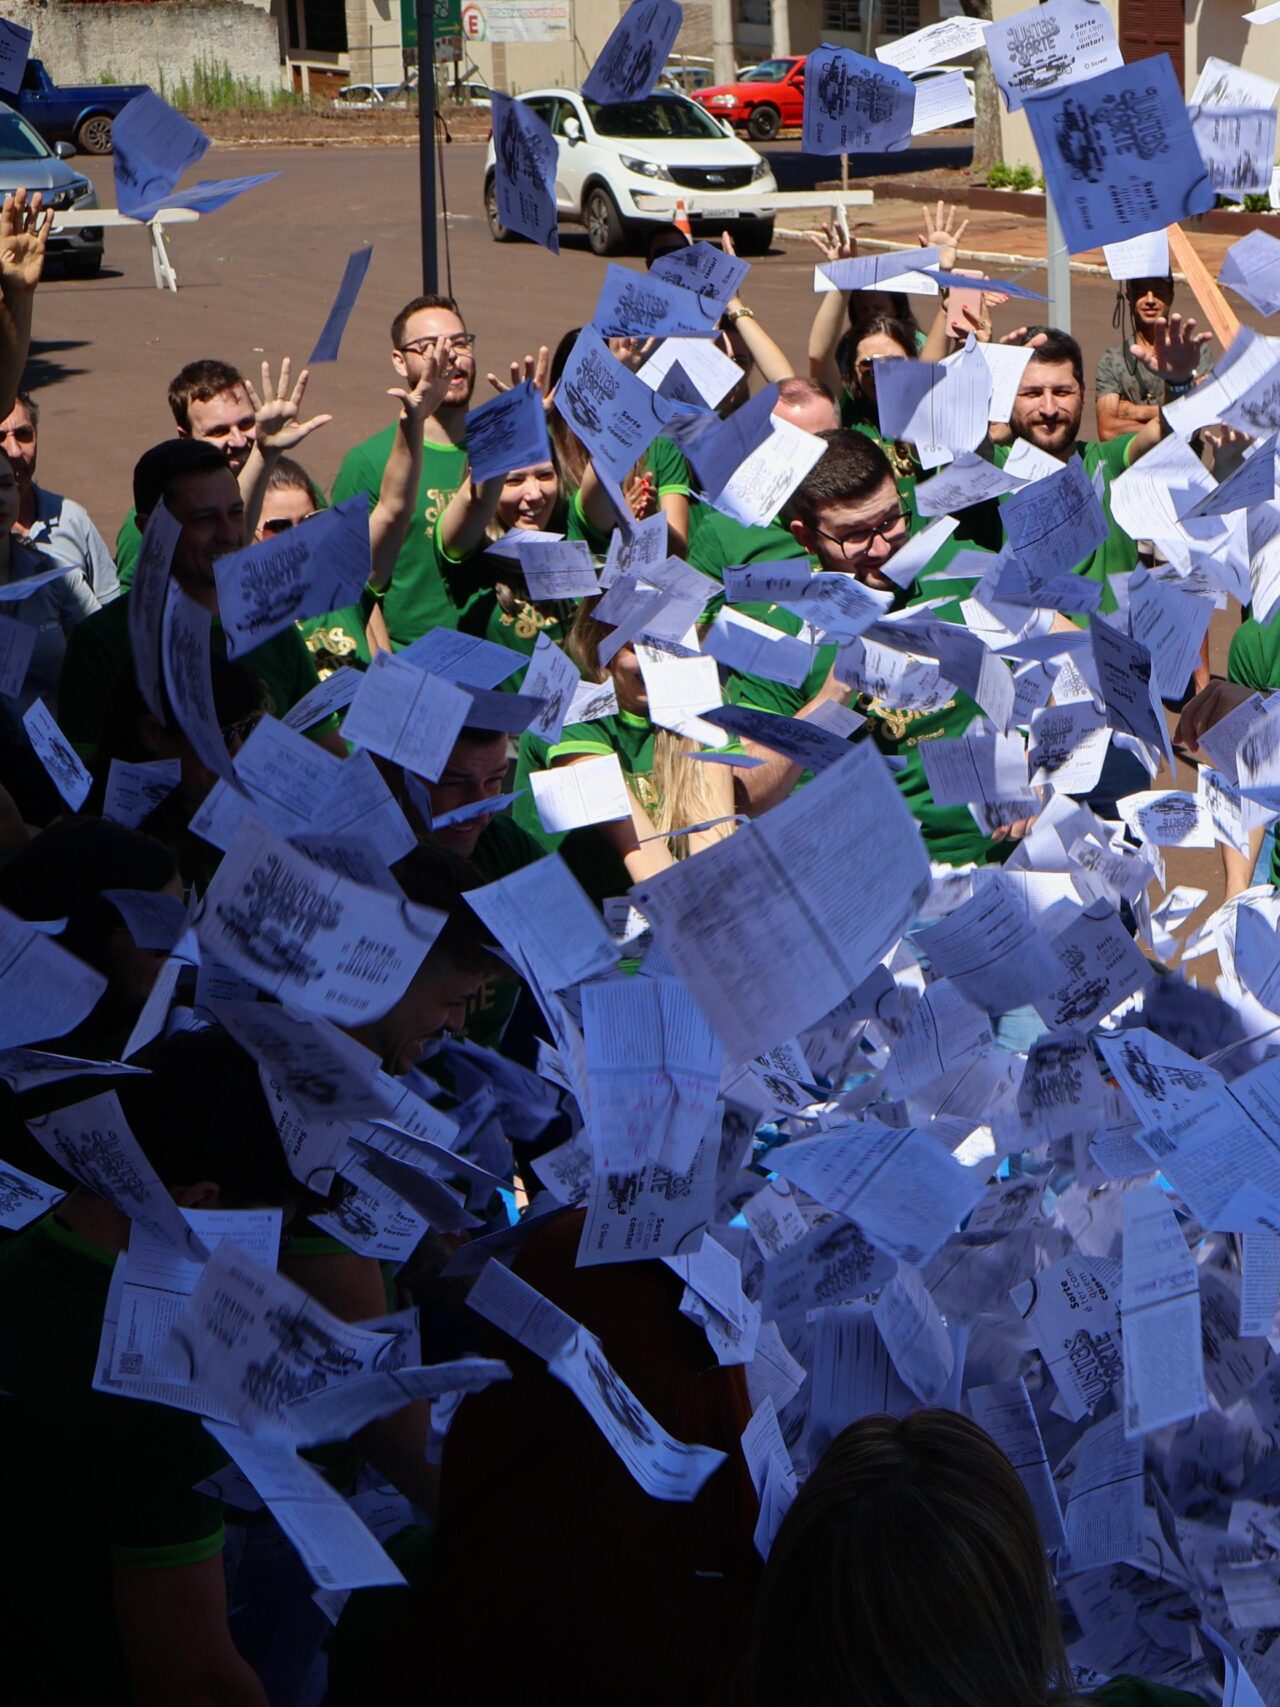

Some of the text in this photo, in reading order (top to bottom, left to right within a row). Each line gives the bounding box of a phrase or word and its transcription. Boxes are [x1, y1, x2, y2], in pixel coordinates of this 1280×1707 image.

[1073, 18, 1097, 31] Sorte
[1075, 35, 1105, 52] contar!
[624, 1216, 637, 1249] contar!
[652, 1217, 666, 1243] Sorte
[1059, 1280, 1080, 1309] Sorte
